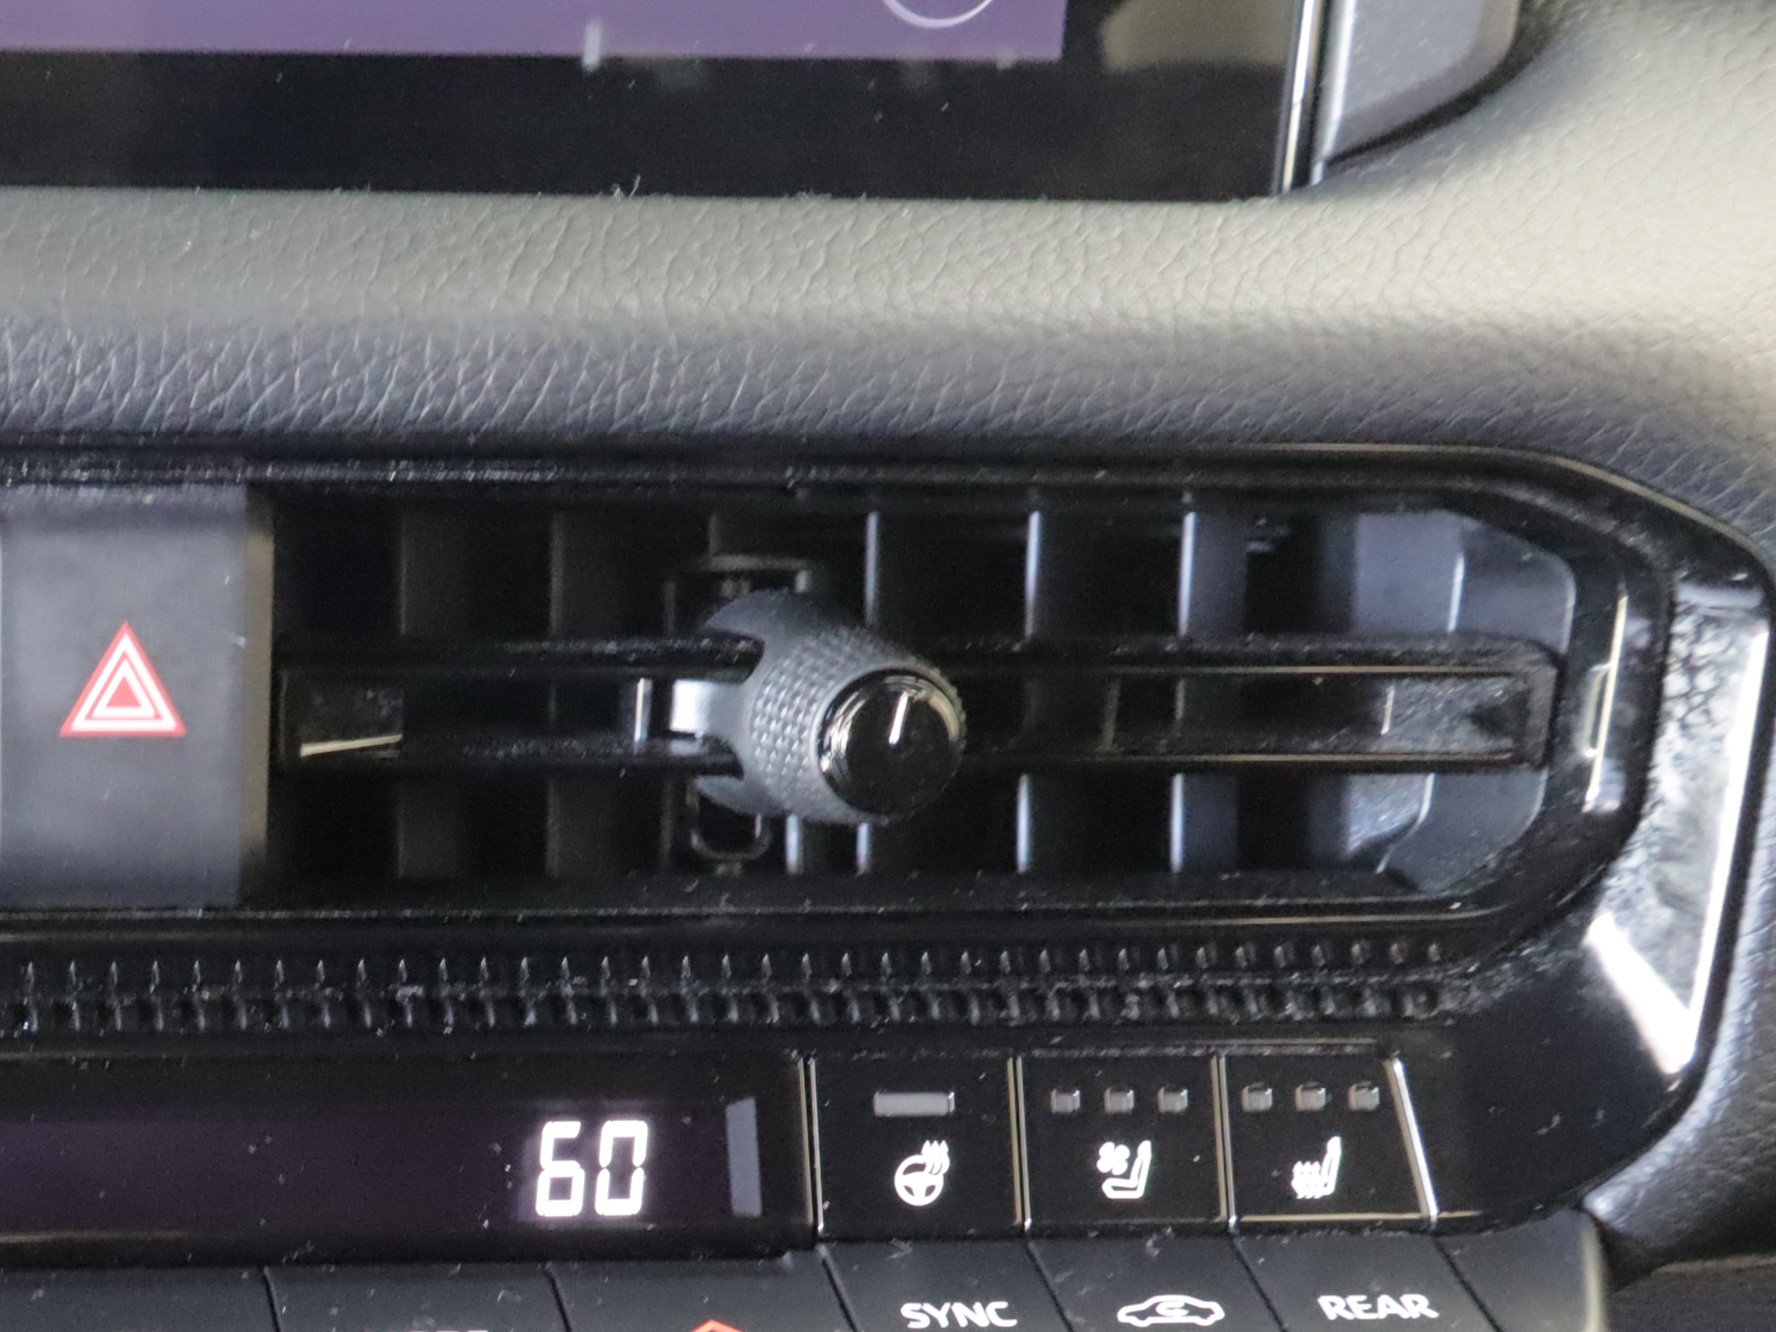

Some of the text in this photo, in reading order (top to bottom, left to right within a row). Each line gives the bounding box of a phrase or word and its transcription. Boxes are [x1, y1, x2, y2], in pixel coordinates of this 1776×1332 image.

[534, 1117, 651, 1220] 60
[899, 1300, 1018, 1330] SYNC
[1316, 1293, 1441, 1321] REAR
